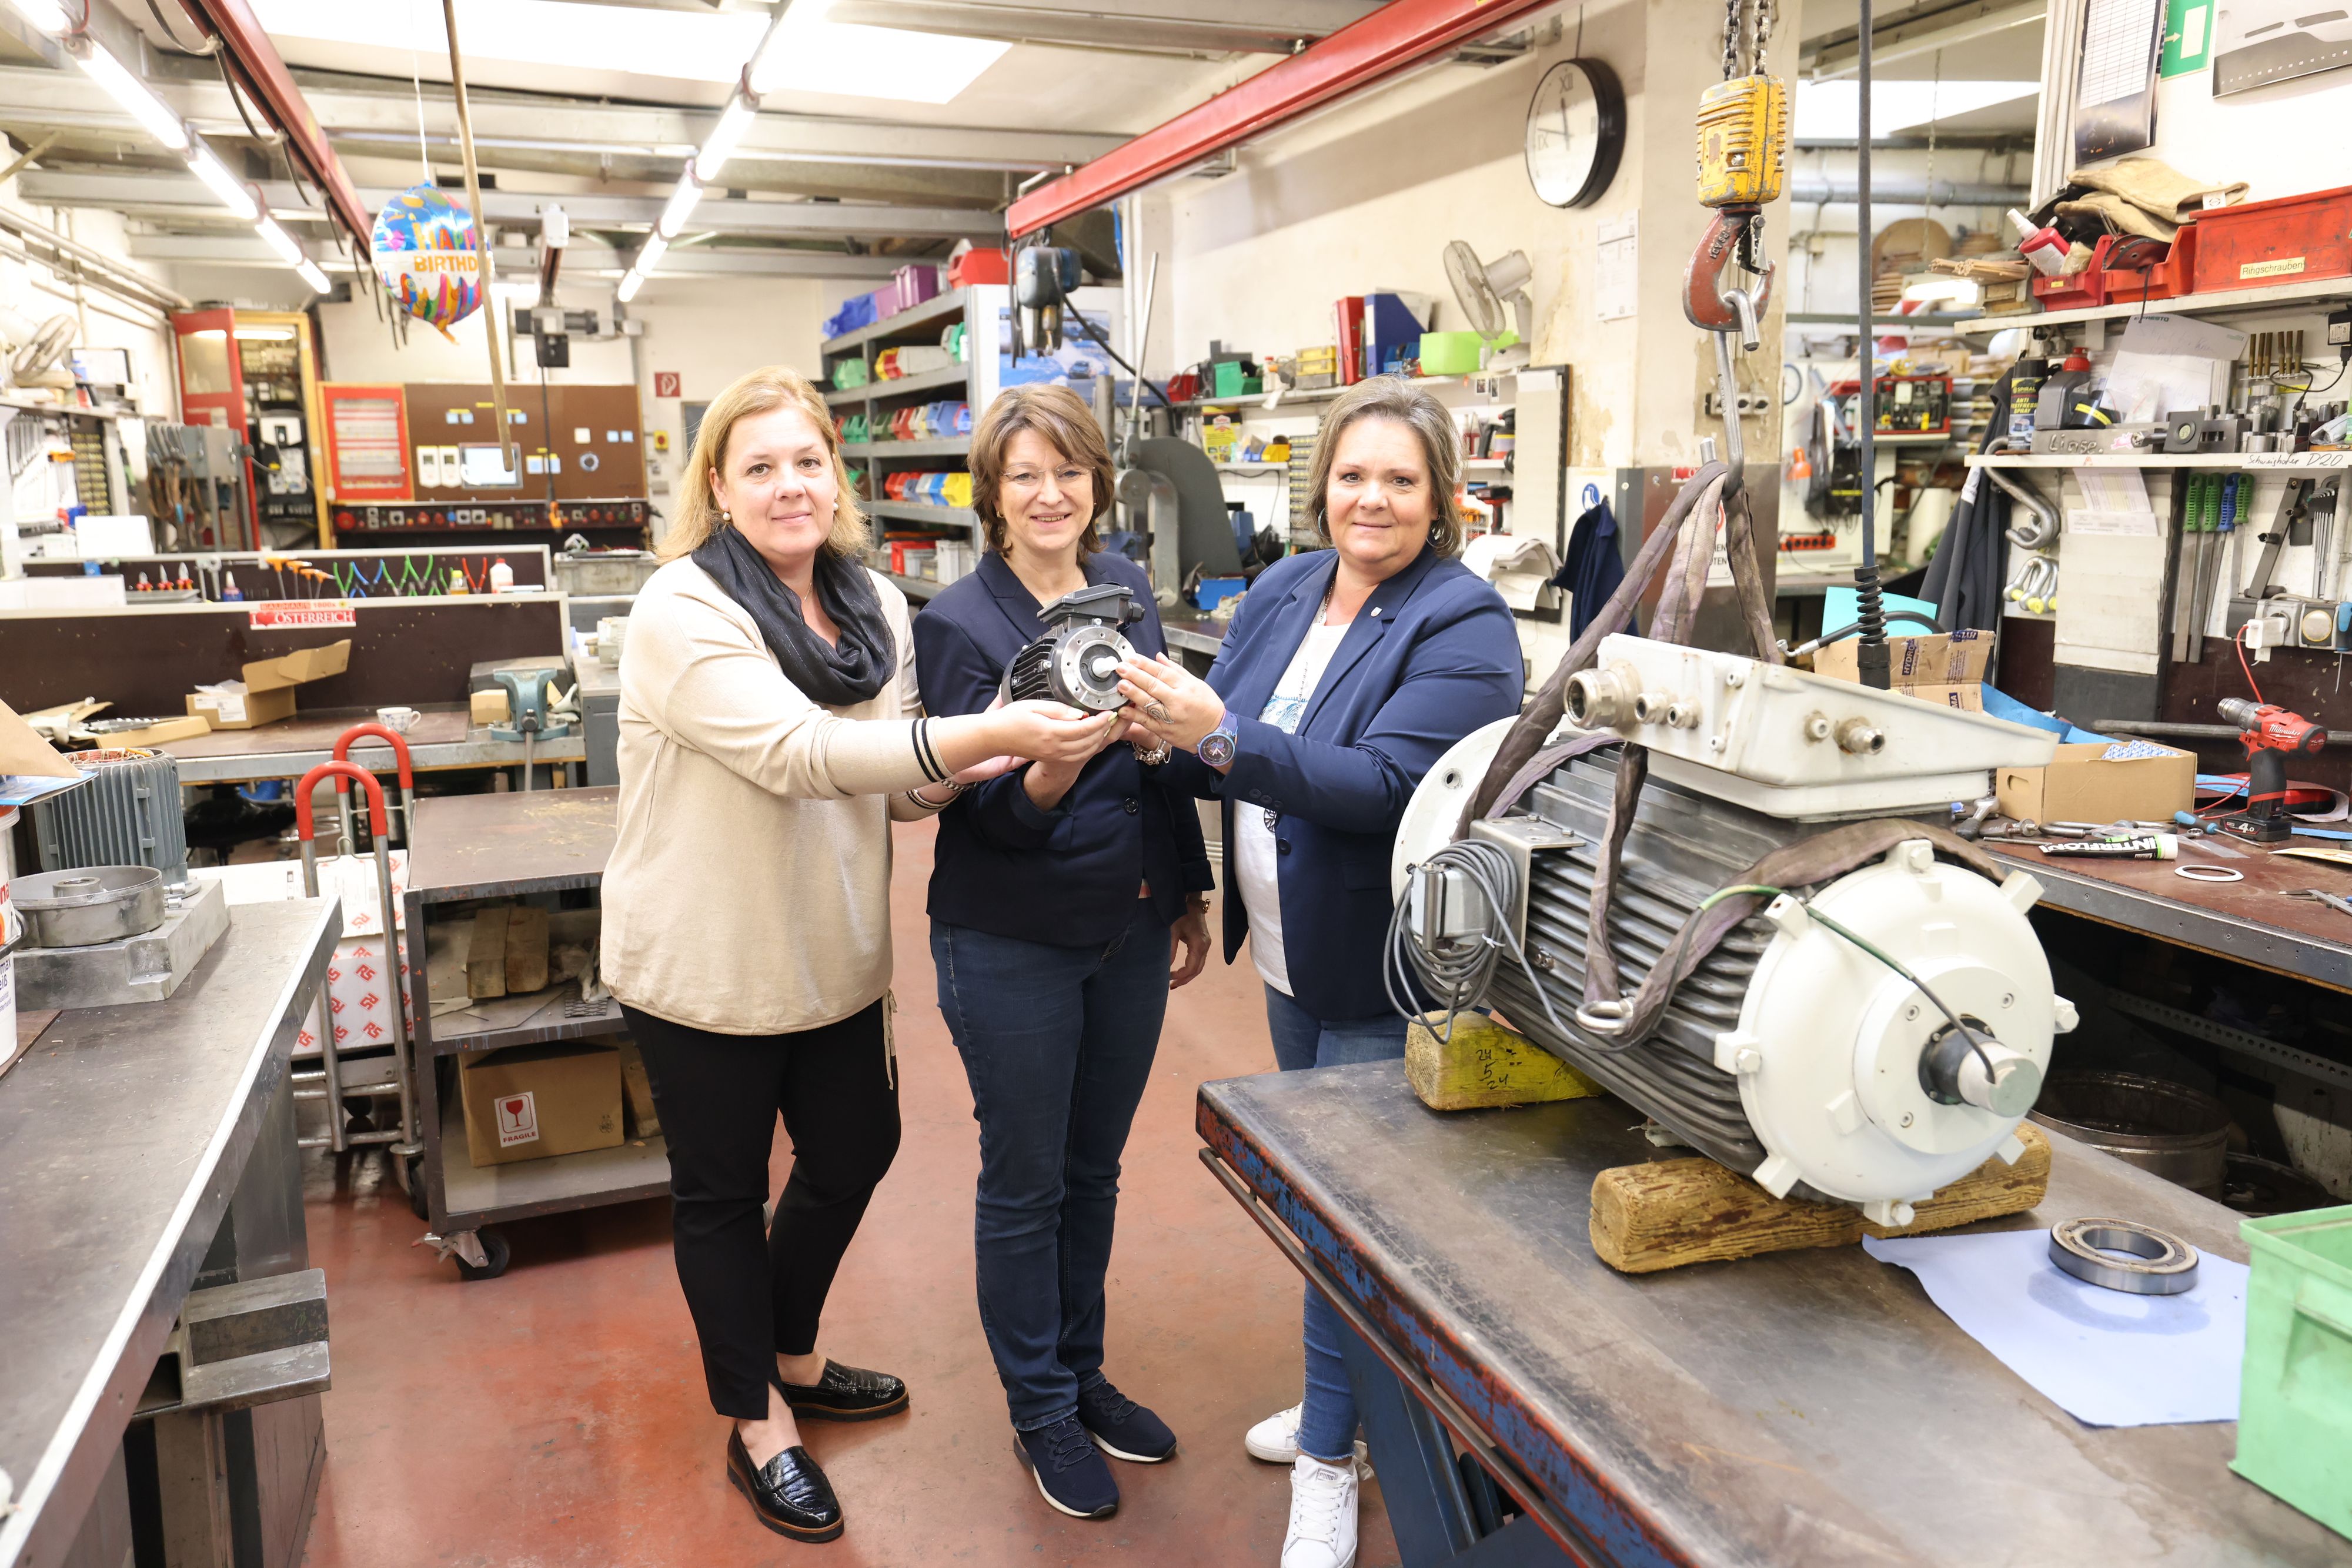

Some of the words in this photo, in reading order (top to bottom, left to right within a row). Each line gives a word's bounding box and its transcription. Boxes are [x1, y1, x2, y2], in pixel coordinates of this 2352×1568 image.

[413, 222, 476, 250] HAPP
[413, 255, 479, 273] BIRTHD
[2243, 262, 2303, 276] Ringschrauben
[2306, 453, 2343, 466] D20
[275, 610, 353, 624] ÖSTERREICH
[2269, 723, 2301, 736] Milwaukee
[356, 964, 376, 981] RS
[363, 1022, 383, 1039] RS
[1479, 1061, 1496, 1081] 5
[1486, 1074, 1508, 1089] 24
[503, 1131, 536, 1143] FRAGILE
[1319, 1472, 1334, 1481] PUMA
